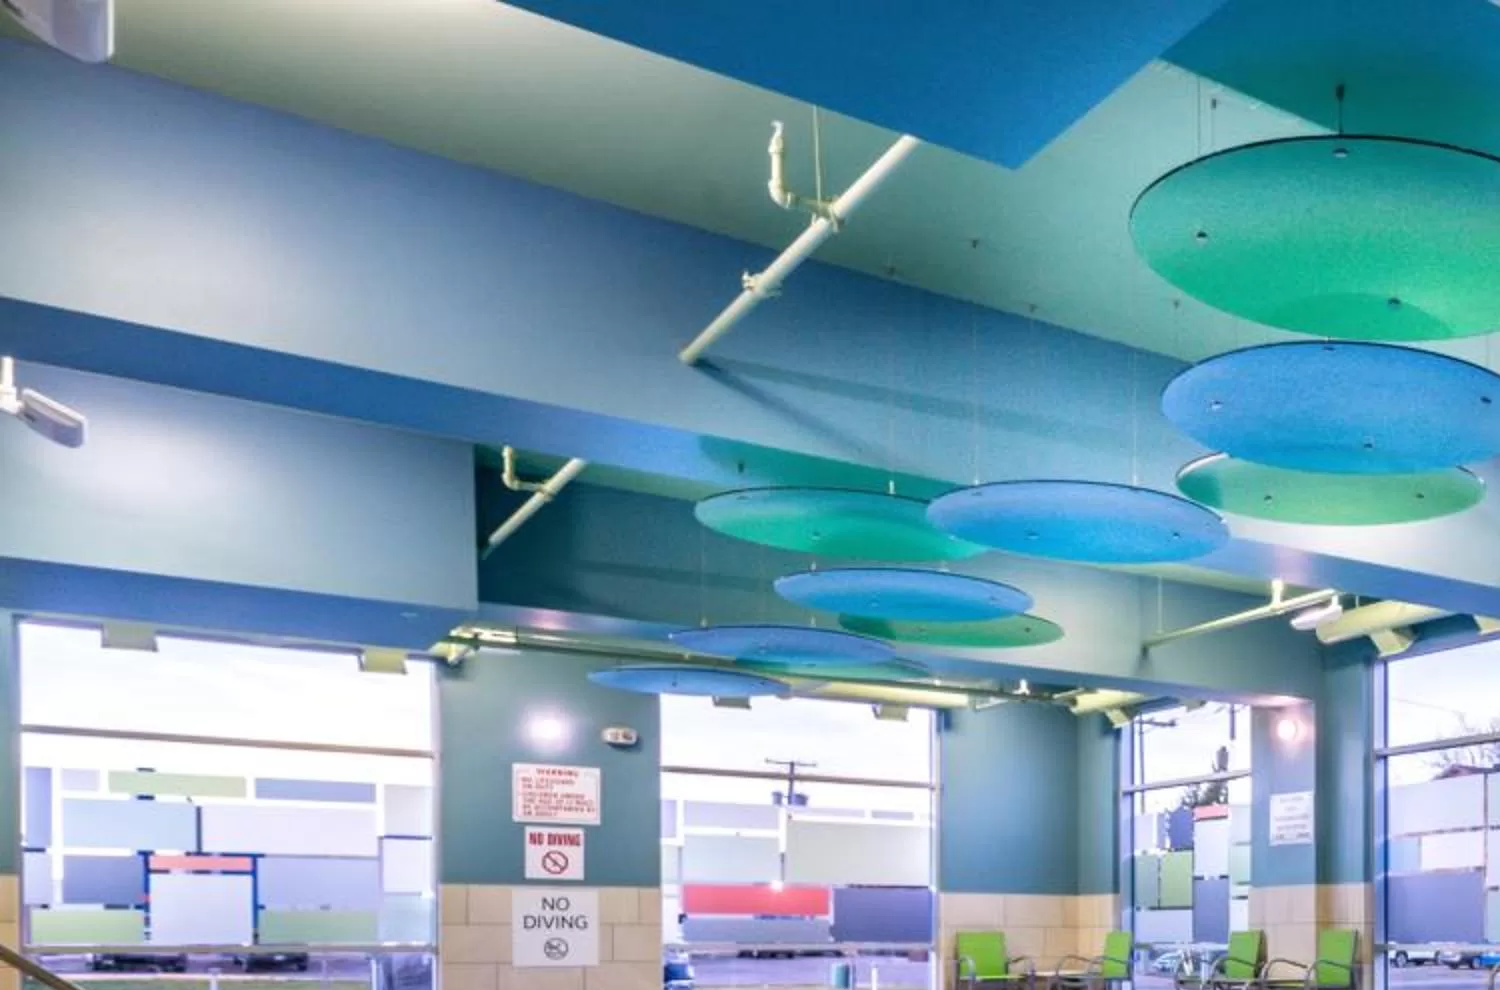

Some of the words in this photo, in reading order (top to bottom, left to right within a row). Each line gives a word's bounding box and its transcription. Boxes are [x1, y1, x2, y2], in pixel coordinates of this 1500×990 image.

[529, 832, 544, 846] NO
[547, 833, 581, 847] DIVING
[541, 897, 570, 911] NO
[523, 915, 589, 930] DIVING
